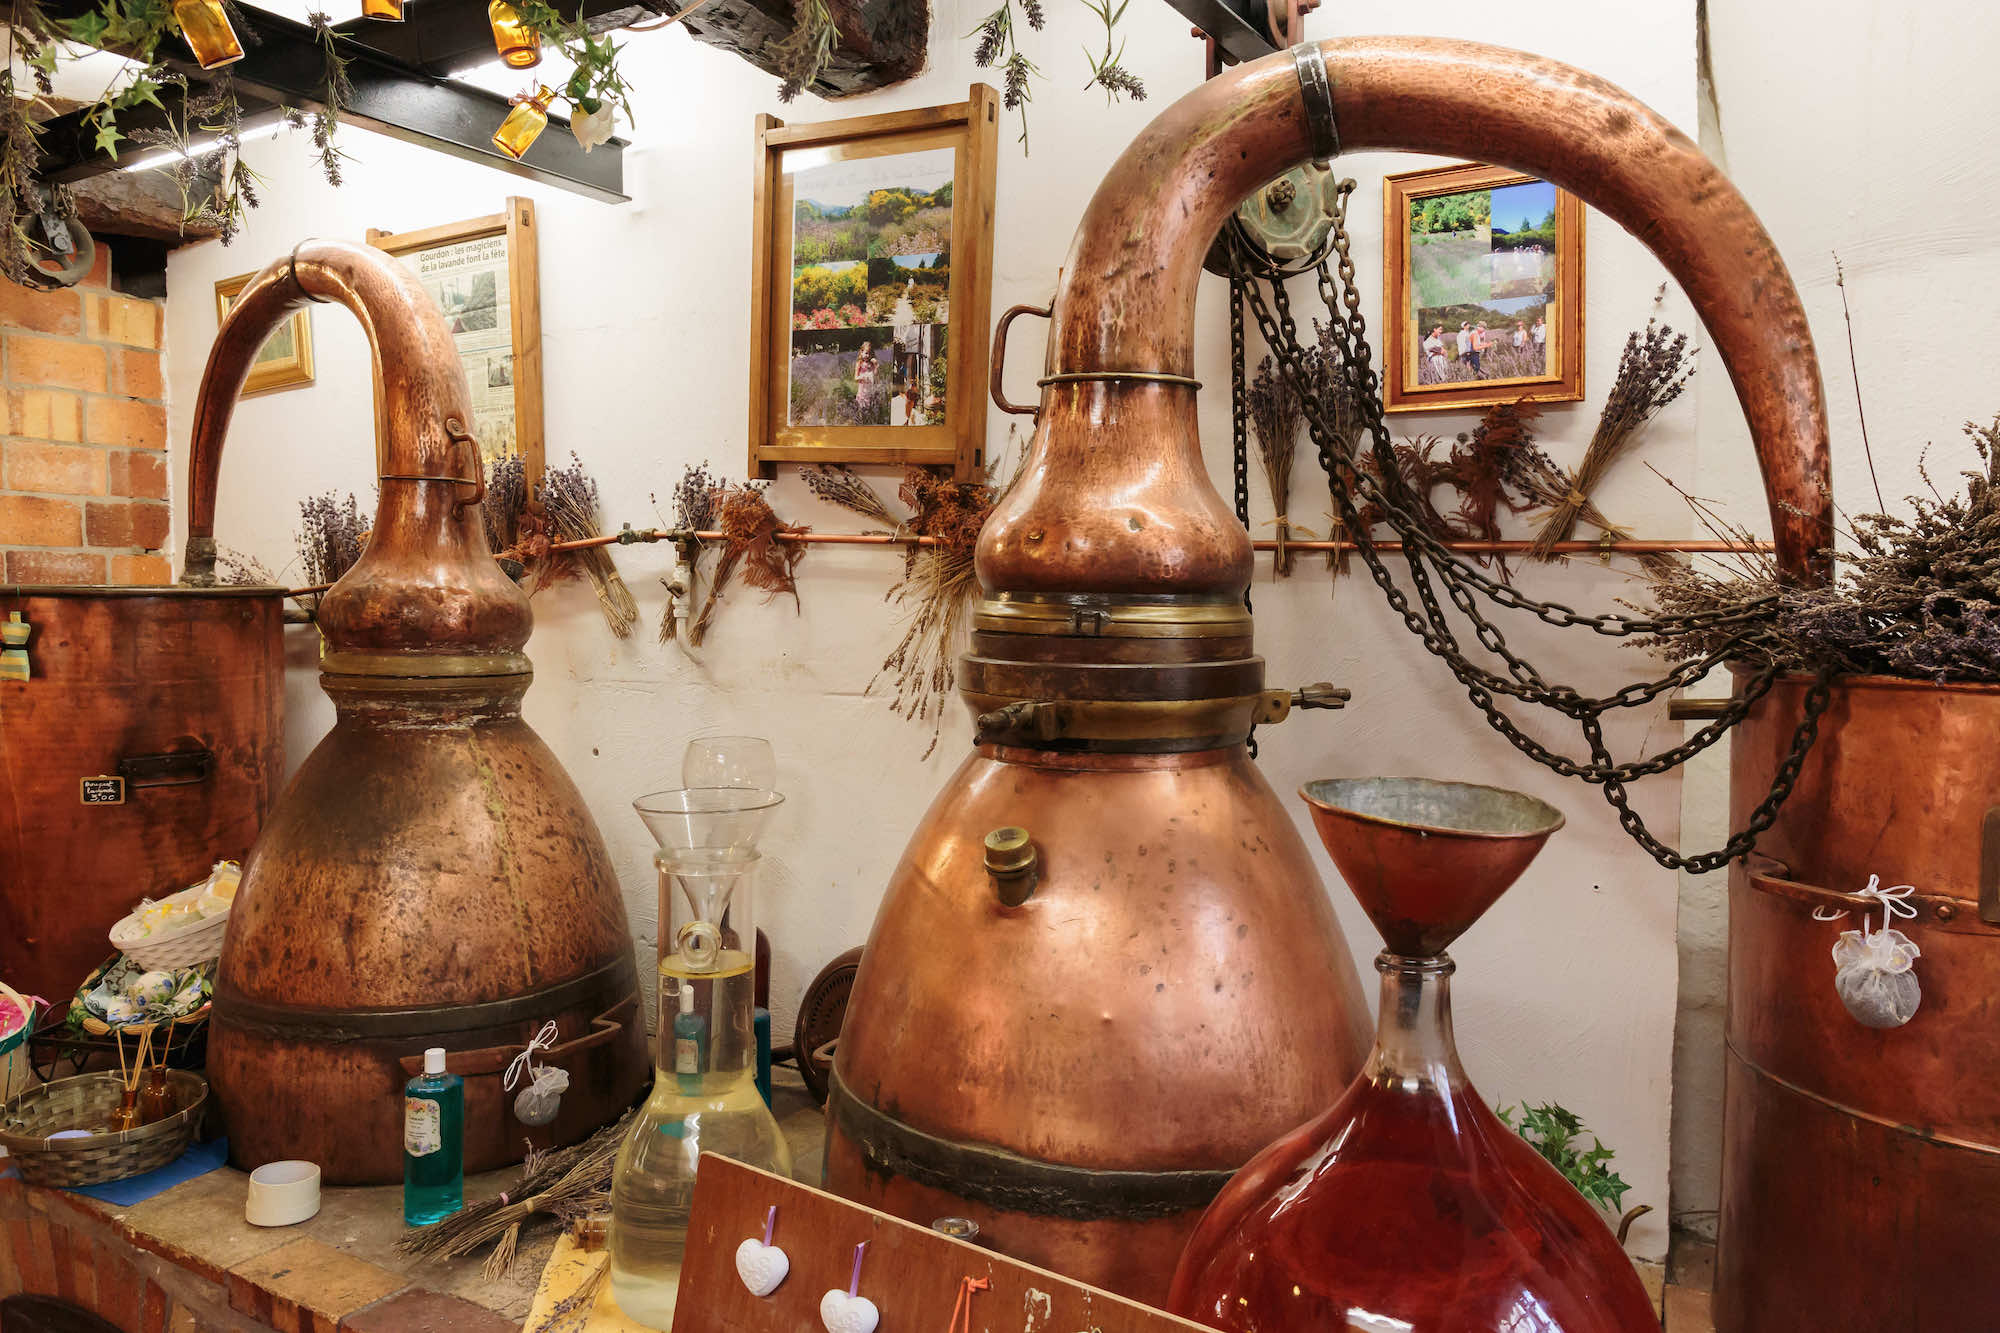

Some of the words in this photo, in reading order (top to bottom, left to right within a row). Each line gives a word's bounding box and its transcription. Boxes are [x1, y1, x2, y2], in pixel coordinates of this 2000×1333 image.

[420, 250, 450, 262] Gourdon
[455, 247, 464, 255] les
[466, 239, 502, 252] magiciens
[421, 263, 430, 272] de
[438, 257, 465, 269] lavande
[466, 254, 481, 264] font
[482, 251, 489, 260] la
[491, 248, 505, 259] fête
